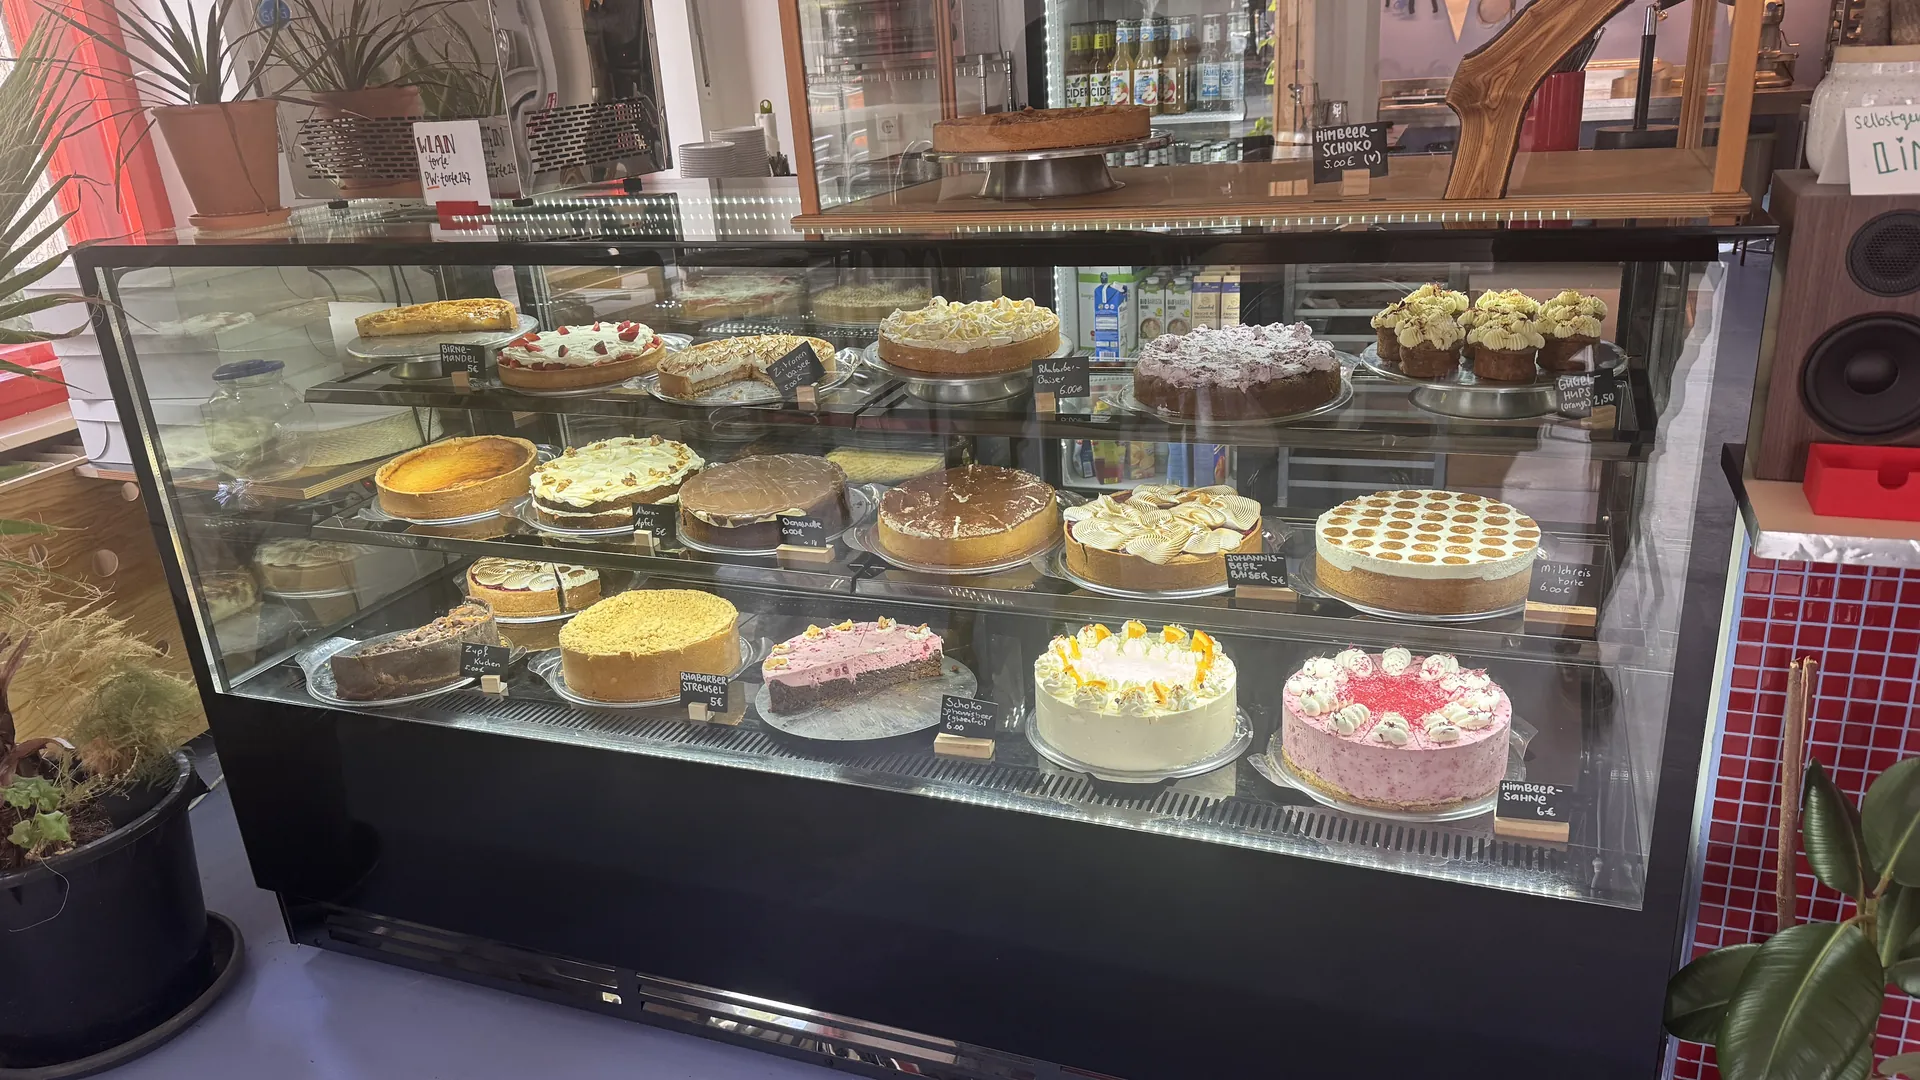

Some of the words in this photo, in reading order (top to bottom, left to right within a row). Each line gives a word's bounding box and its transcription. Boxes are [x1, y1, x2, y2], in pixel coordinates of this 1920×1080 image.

[1091, 86, 1111, 97] CIDE
[416, 133, 456, 154] WLAN
[1322, 139, 1372, 157] SCHOKO
[467, 364, 479, 373] 5€
[634, 517, 654, 529] Apfel
[655, 527, 667, 536] 5€
[1226, 554, 1284, 563] JOHANNIS-
[1270, 575, 1286, 585] 5€
[710, 696, 724, 707] 5€
